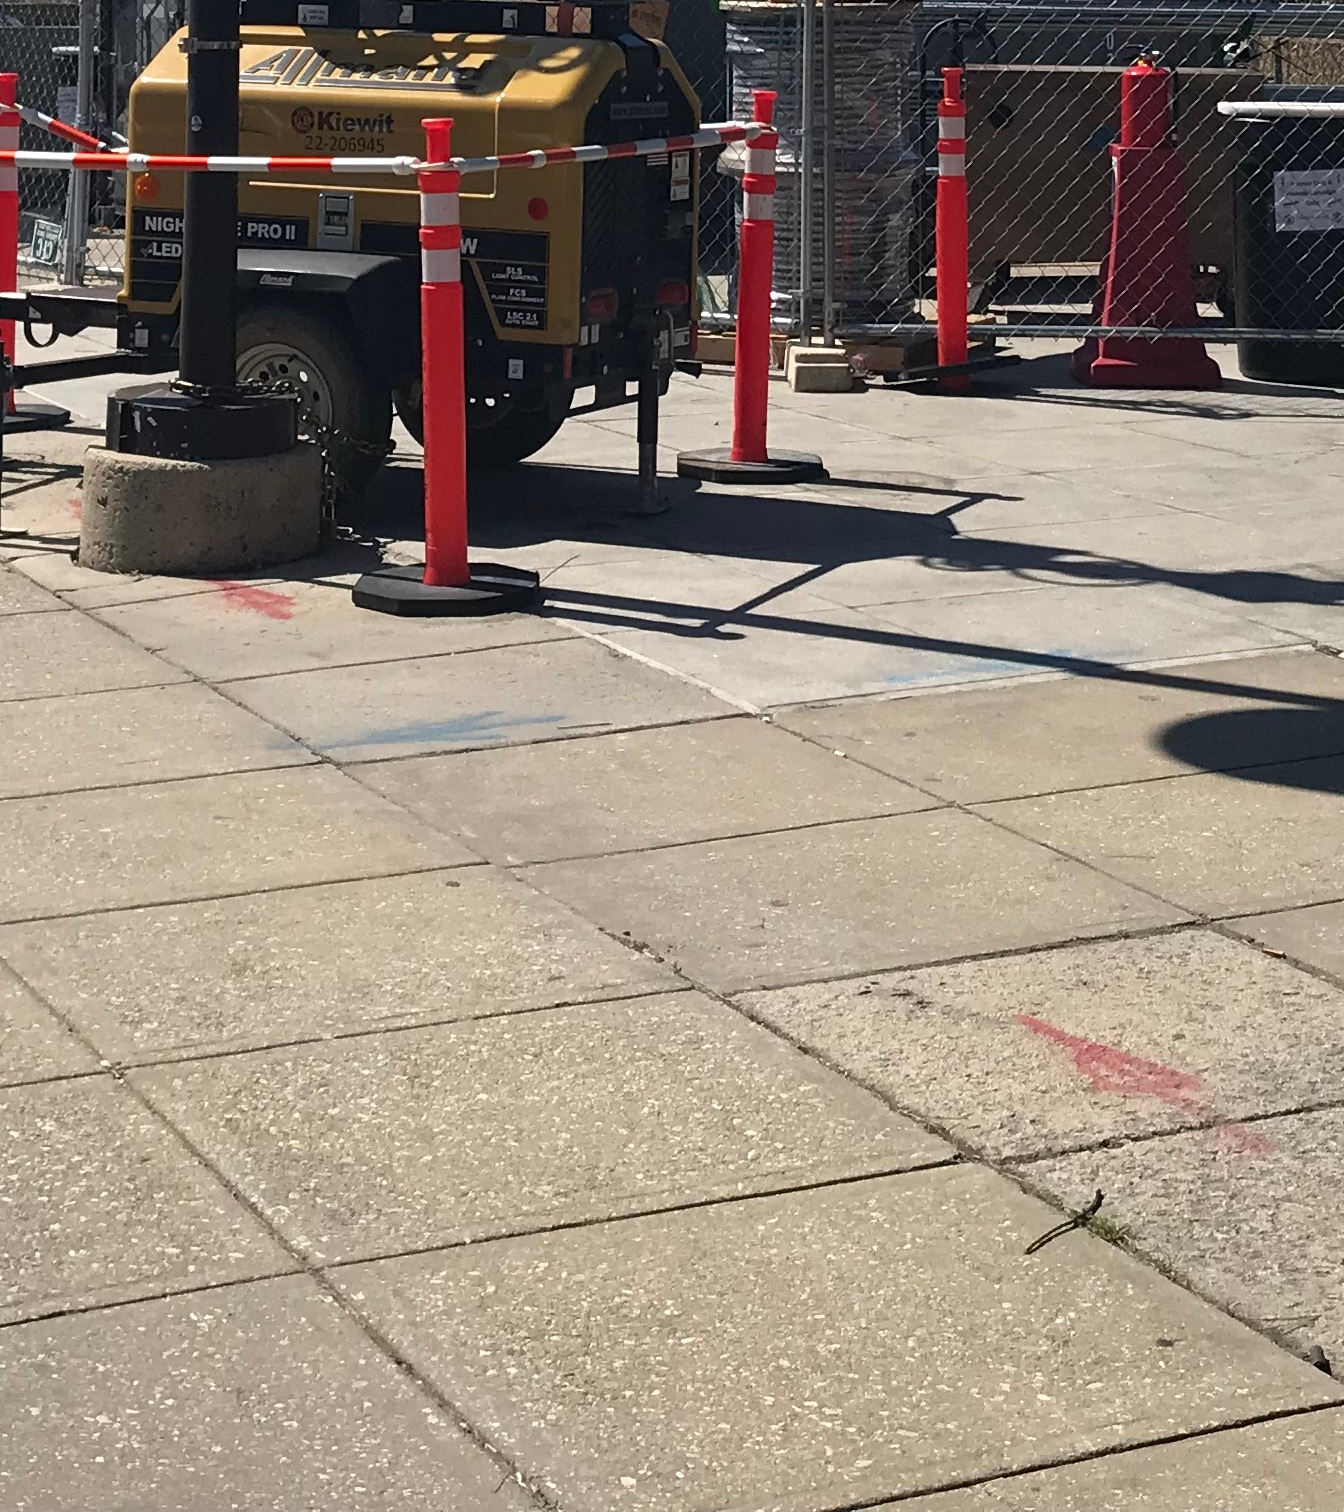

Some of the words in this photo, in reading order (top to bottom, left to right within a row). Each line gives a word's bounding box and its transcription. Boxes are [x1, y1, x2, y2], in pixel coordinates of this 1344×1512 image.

[243, 46, 496, 89] Allmand
[317, 107, 395, 134] Kiewit
[305, 136, 385, 153] 22-206945
[247, 223, 282, 239] PRO
[285, 225, 296, 240] II
[152, 242, 182, 258] LED
[509, 288, 527, 297] FCS
[507, 311, 524, 320] LSC
